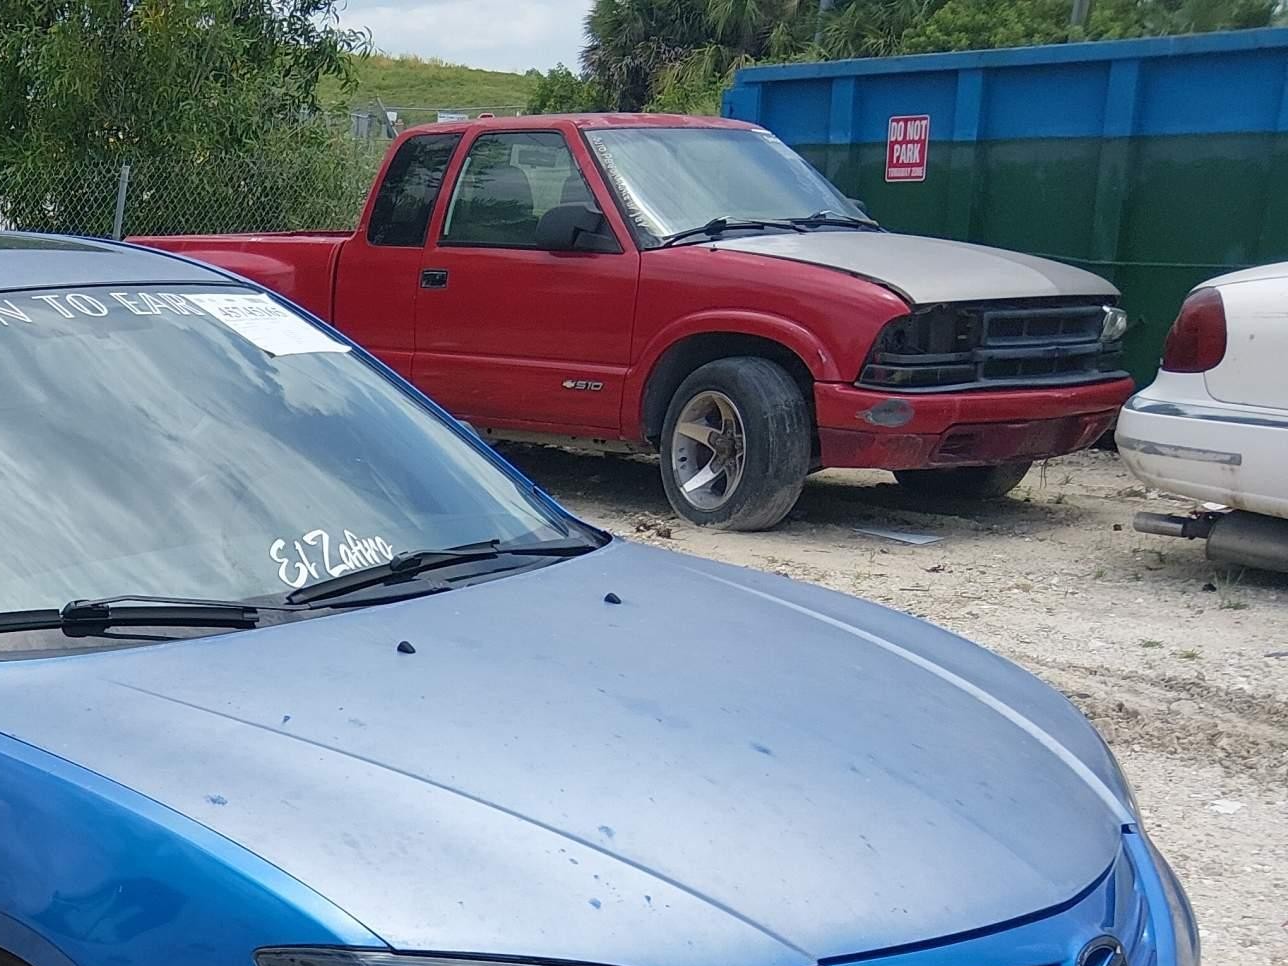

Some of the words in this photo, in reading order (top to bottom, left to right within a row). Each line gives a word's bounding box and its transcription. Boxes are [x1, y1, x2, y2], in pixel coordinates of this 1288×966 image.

[891, 121, 905, 141] DO
[907, 120, 927, 140] NOT
[893, 143, 921, 164] PARK
[31, 293, 109, 319] TO
[575, 381, 604, 391] S10
